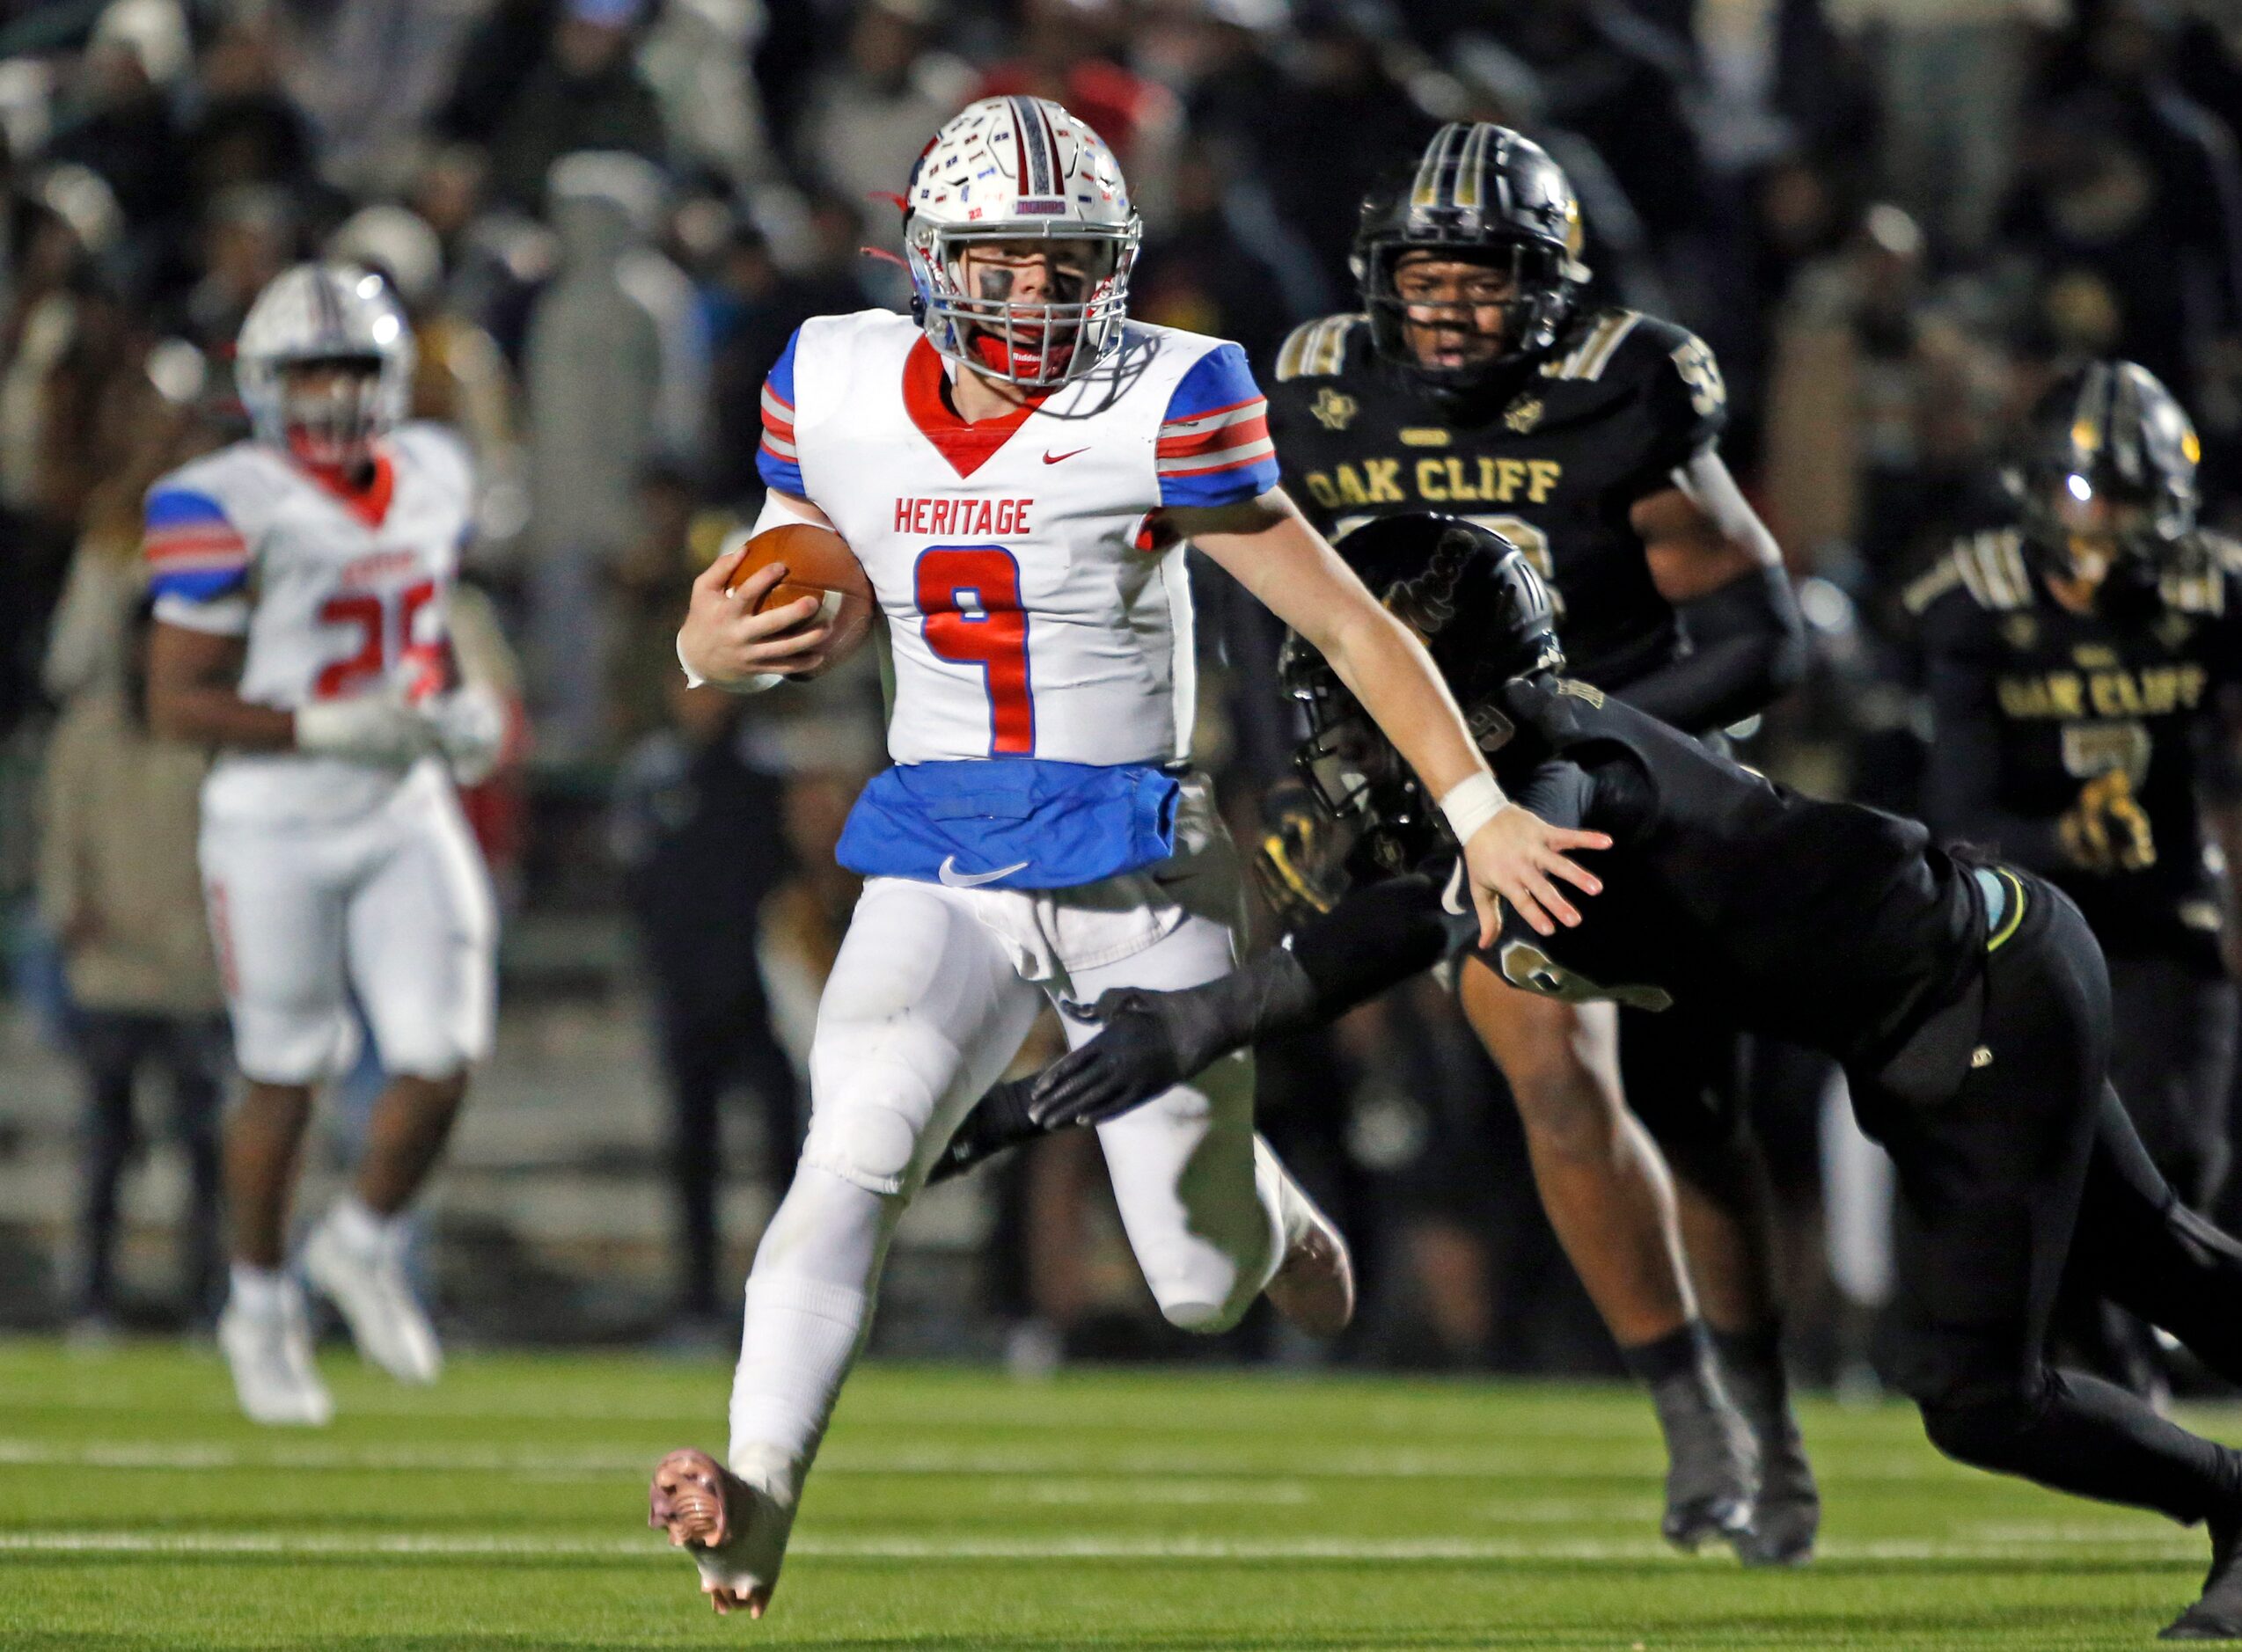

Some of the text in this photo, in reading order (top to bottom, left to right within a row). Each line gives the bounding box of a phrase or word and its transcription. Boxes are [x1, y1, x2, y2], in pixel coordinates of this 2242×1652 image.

[968, 208, 983, 220] 22
[1306, 456, 1564, 508] OAK CLIFF
[894, 498, 1034, 536] HERITAGE
[913, 545, 1037, 759] 9
